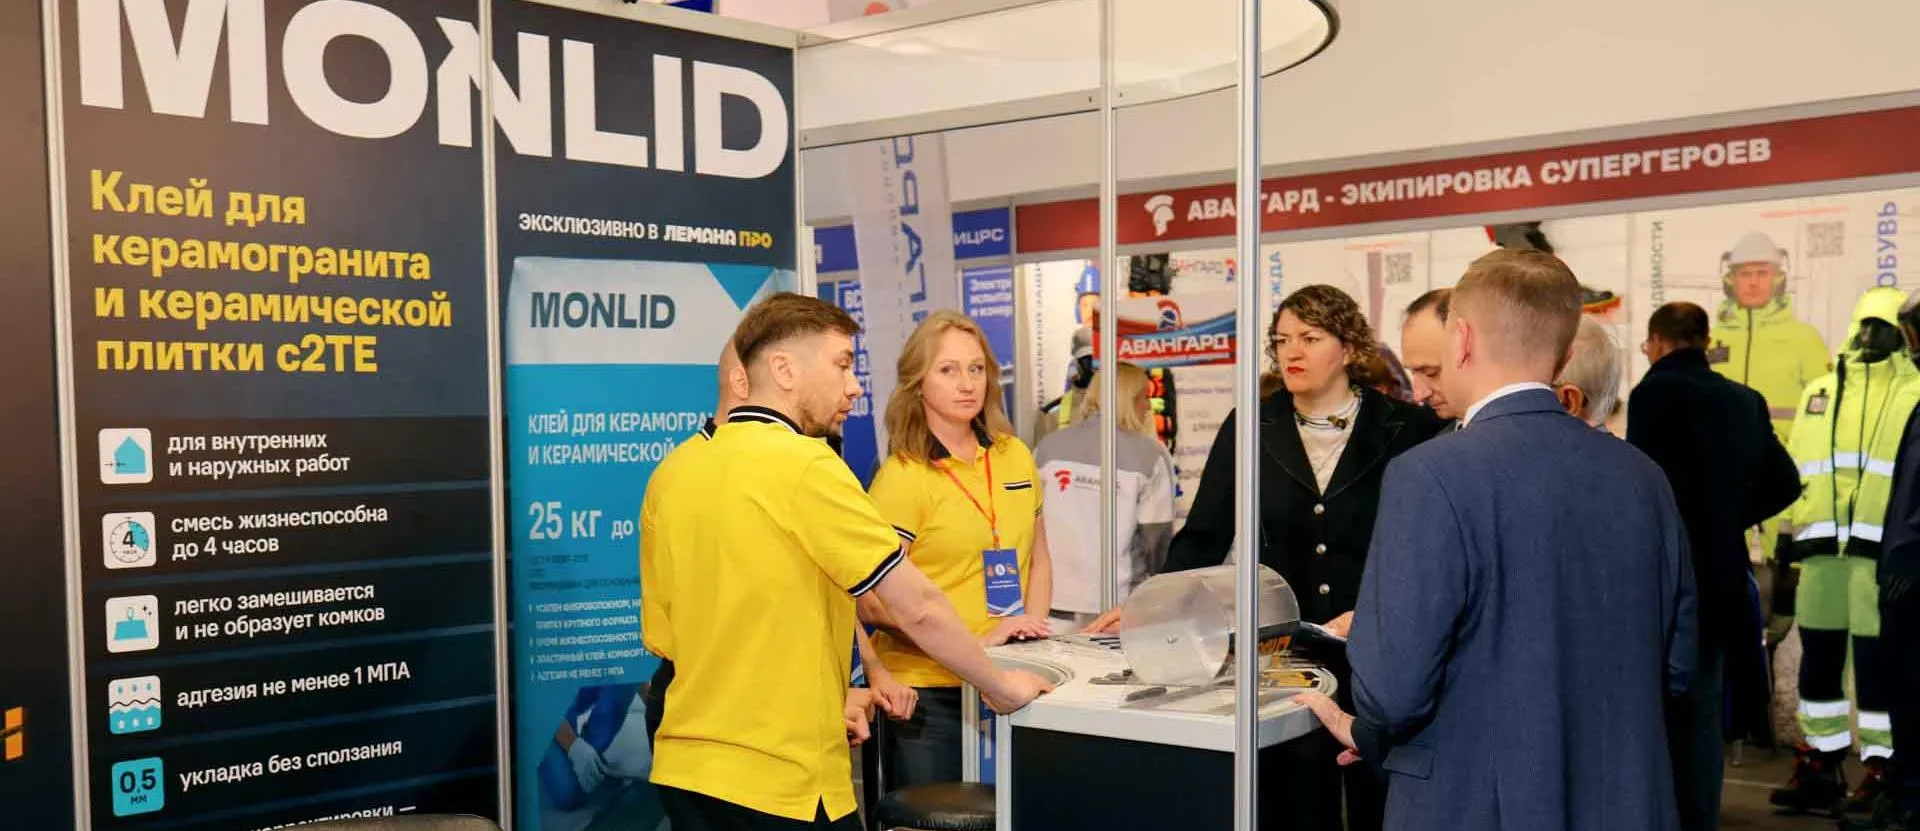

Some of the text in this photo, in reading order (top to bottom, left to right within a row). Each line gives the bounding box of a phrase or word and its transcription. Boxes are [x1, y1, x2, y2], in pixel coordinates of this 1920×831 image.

[77, 0, 788, 178] MONLID
[1187, 188, 1320, 221] АВААРД
[1341, 163, 1532, 206] ЭКИПИРОВКА
[1541, 138, 1771, 186] СУПЕРГЕРОЕВ
[91, 170, 305, 227] Клей для
[519, 213, 773, 249] ЭКСКЛЮЗИВНО В ЛЕМАНА ПРО
[1877, 201, 1897, 287] ОБУВЬ
[93, 233, 430, 282] керамогранита
[95, 287, 452, 329] и керамической
[530, 292, 676, 329] MONLID
[97, 334, 377, 372] плитки с2ТЕ
[1119, 333, 1231, 356] АВАНГАРД
[528, 410, 713, 436] КЛЕЙ ДЛЯ КЕРАМОГРА
[168, 432, 327, 454] для внутренних
[528, 445, 539, 465] И
[169, 453, 351, 480] и наружных работ
[171, 505, 388, 534] смесь жизнеспособна
[529, 501, 563, 540] 25
[611, 520, 634, 540] до
[123, 531, 136, 547] 4
[172, 536, 280, 561] до 4 часов
[174, 583, 375, 617] легко замешивается
[175, 607, 385, 640] и не образует комков
[177, 660, 411, 708] адгезия не менее 1 МПА
[120, 768, 156, 793] 0,5
[180, 739, 402, 792] укладка без сползания
